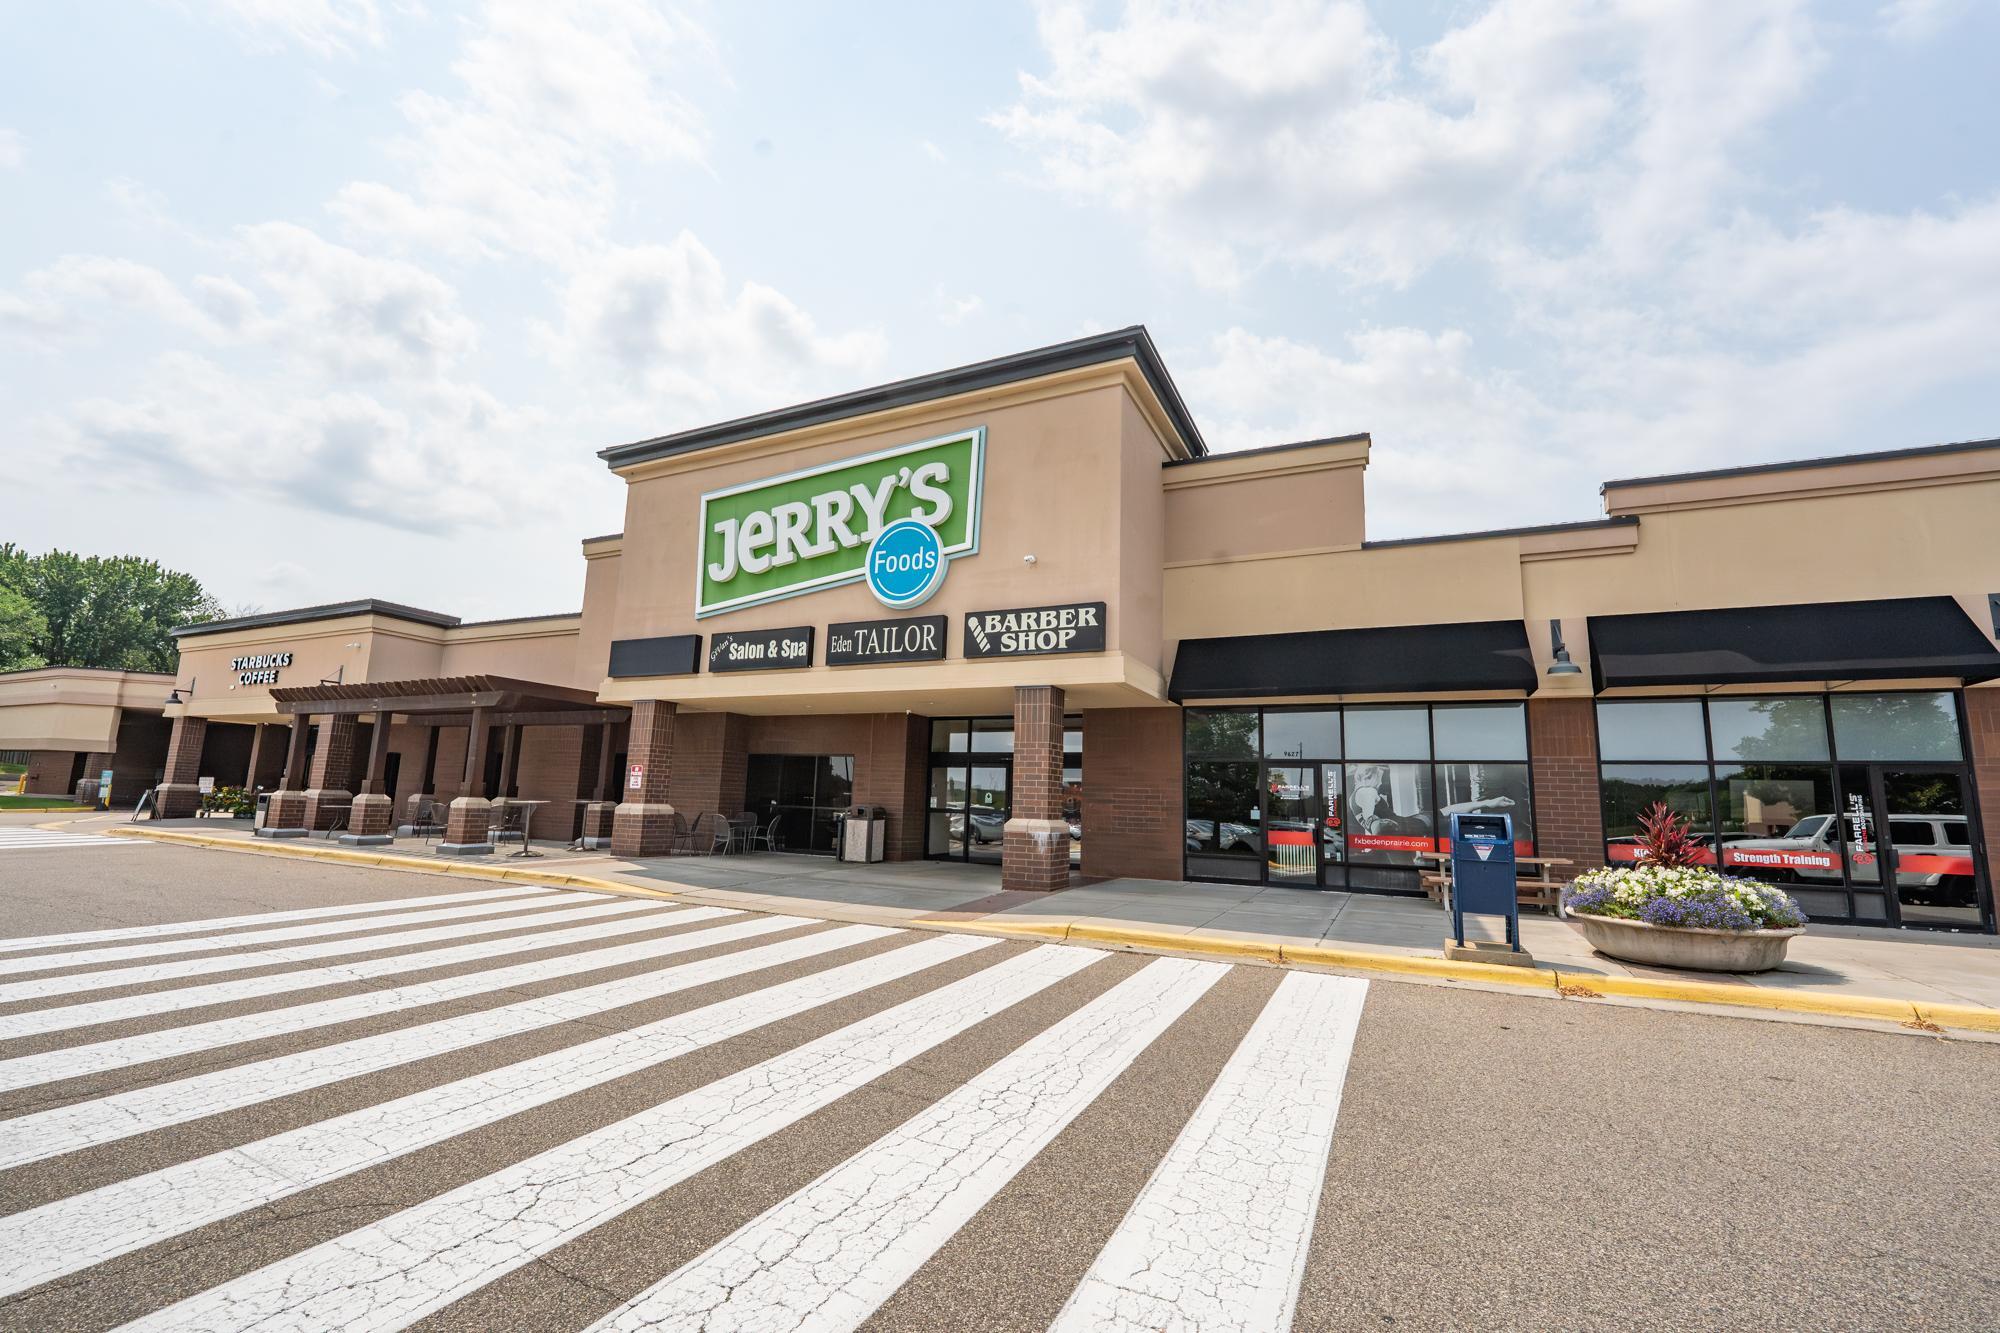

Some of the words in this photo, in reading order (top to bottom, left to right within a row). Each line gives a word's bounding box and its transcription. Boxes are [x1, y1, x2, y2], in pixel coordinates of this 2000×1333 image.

[874, 546, 936, 574] Foods
[984, 607, 1099, 633] BARBER
[729, 642, 765, 660] Salon
[767, 640, 778, 658] &
[781, 638, 807, 659] Spa
[831, 635, 852, 653] Eden
[854, 624, 938, 655] TAILOR
[1000, 629, 1077, 652] SHOP
[231, 653, 292, 671] STARBUCKS
[238, 670, 279, 685] COFFEE
[1849, 793, 1864, 852] FARRELL'S
[1354, 836, 1429, 848] fxbedenprairie.com
[1733, 852, 1782, 865] Strength
[1782, 854, 1831, 867] Training
